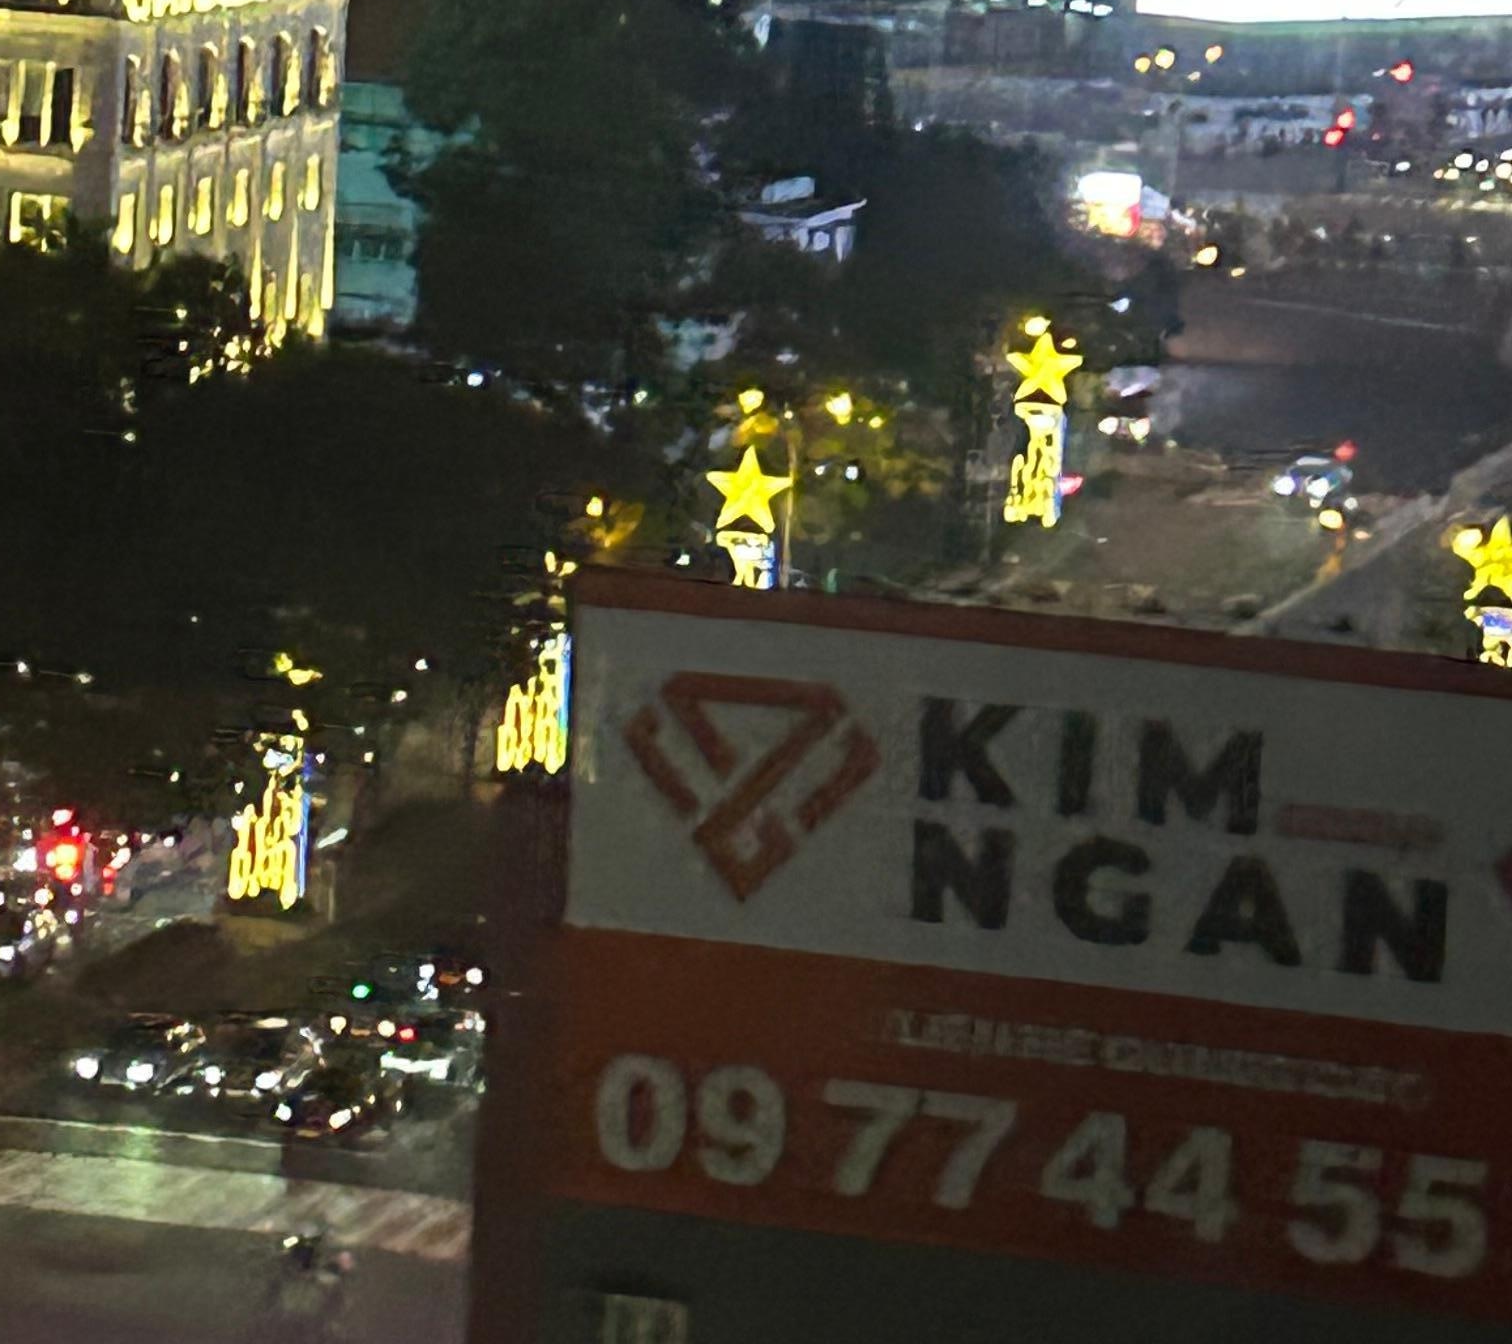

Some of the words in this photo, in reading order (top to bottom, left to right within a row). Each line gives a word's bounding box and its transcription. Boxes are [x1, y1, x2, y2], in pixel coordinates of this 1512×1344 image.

[918, 696, 1265, 835] KIM
[909, 818, 1449, 983] NGAN
[595, 1052, 788, 1187] 09
[822, 1077, 1020, 1211] 77
[1039, 1109, 1239, 1245] 44
[1284, 1136, 1491, 1280] 55
